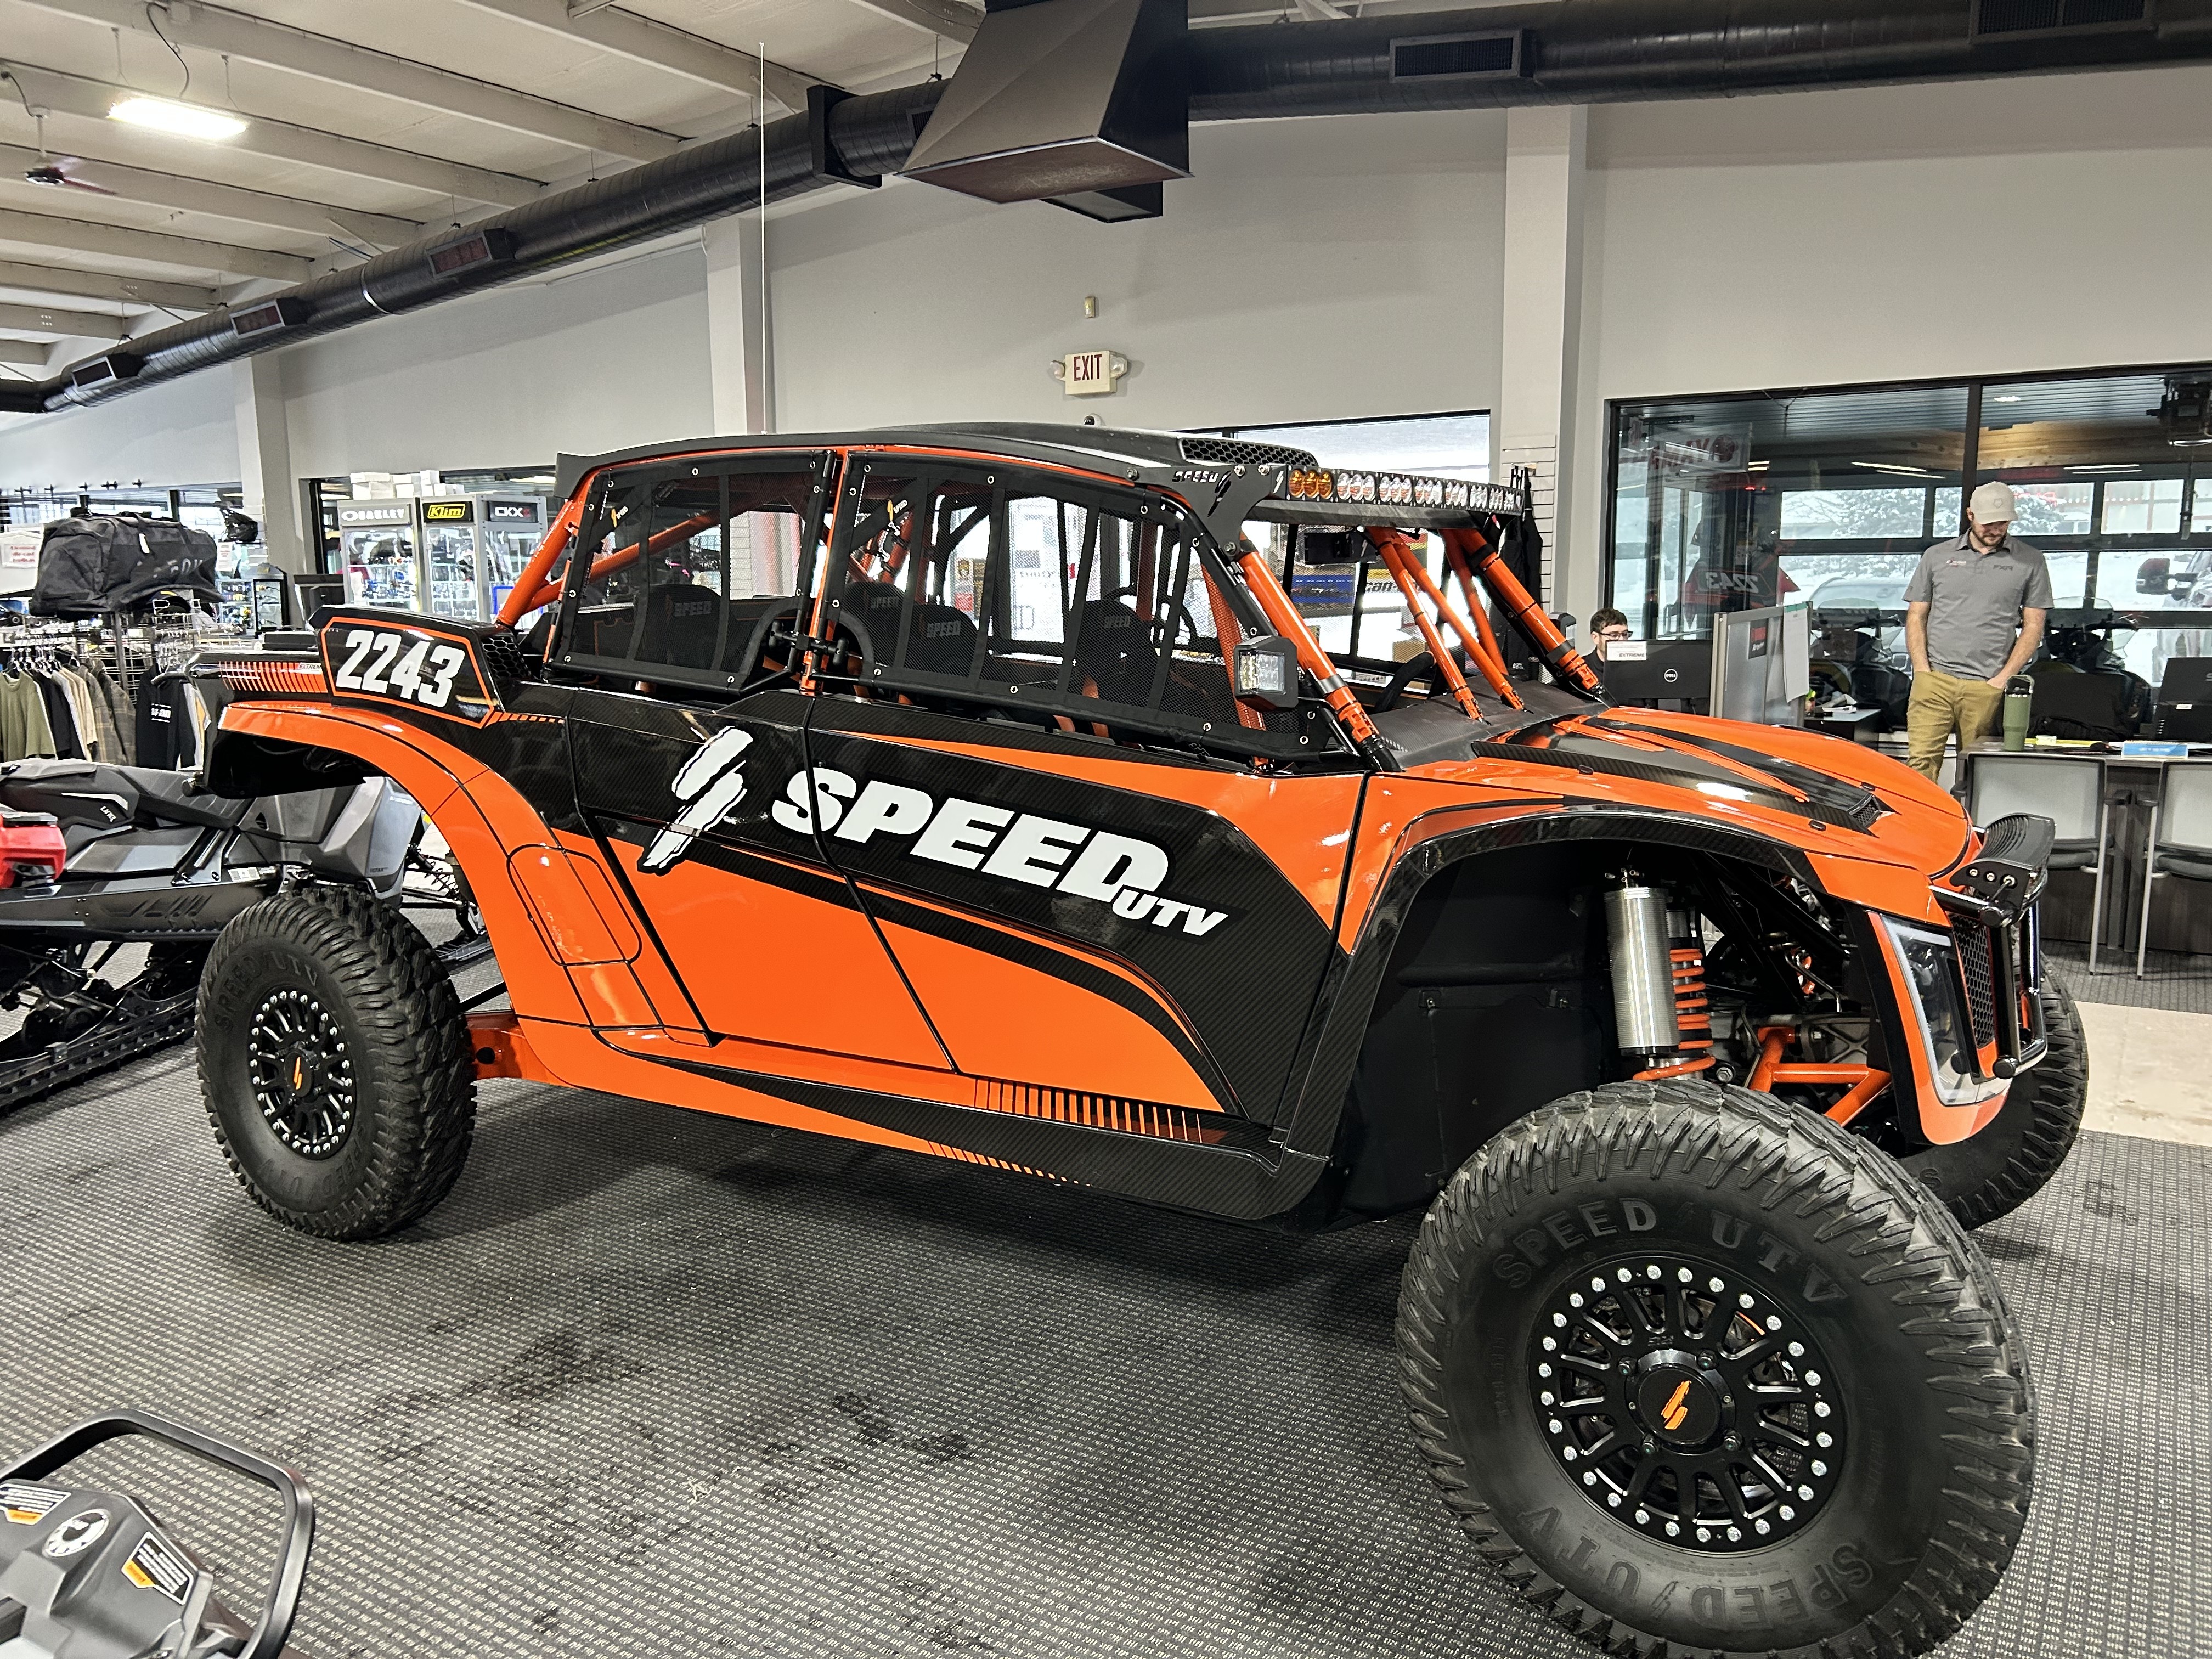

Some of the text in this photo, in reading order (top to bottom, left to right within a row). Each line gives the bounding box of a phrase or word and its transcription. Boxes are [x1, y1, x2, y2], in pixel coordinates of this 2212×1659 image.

[1074, 354, 1102, 381] EXIT
[1172, 471, 1218, 483] SPEED
[358, 509, 405, 520] OAKLEY
[431, 507, 461, 517] Klim
[495, 507, 524, 517] CKX
[893, 499, 907, 514] SPEED
[674, 600, 712, 617] SPEED
[927, 620, 961, 637] SPEED
[336, 630, 465, 708] 2243
[771, 766, 1229, 936] SPEED UTV
[1492, 1198, 1850, 1303] SPEED UTV
[1516, 1505, 1641, 1606] UTV
[1691, 1542, 1875, 1630] SPEED
